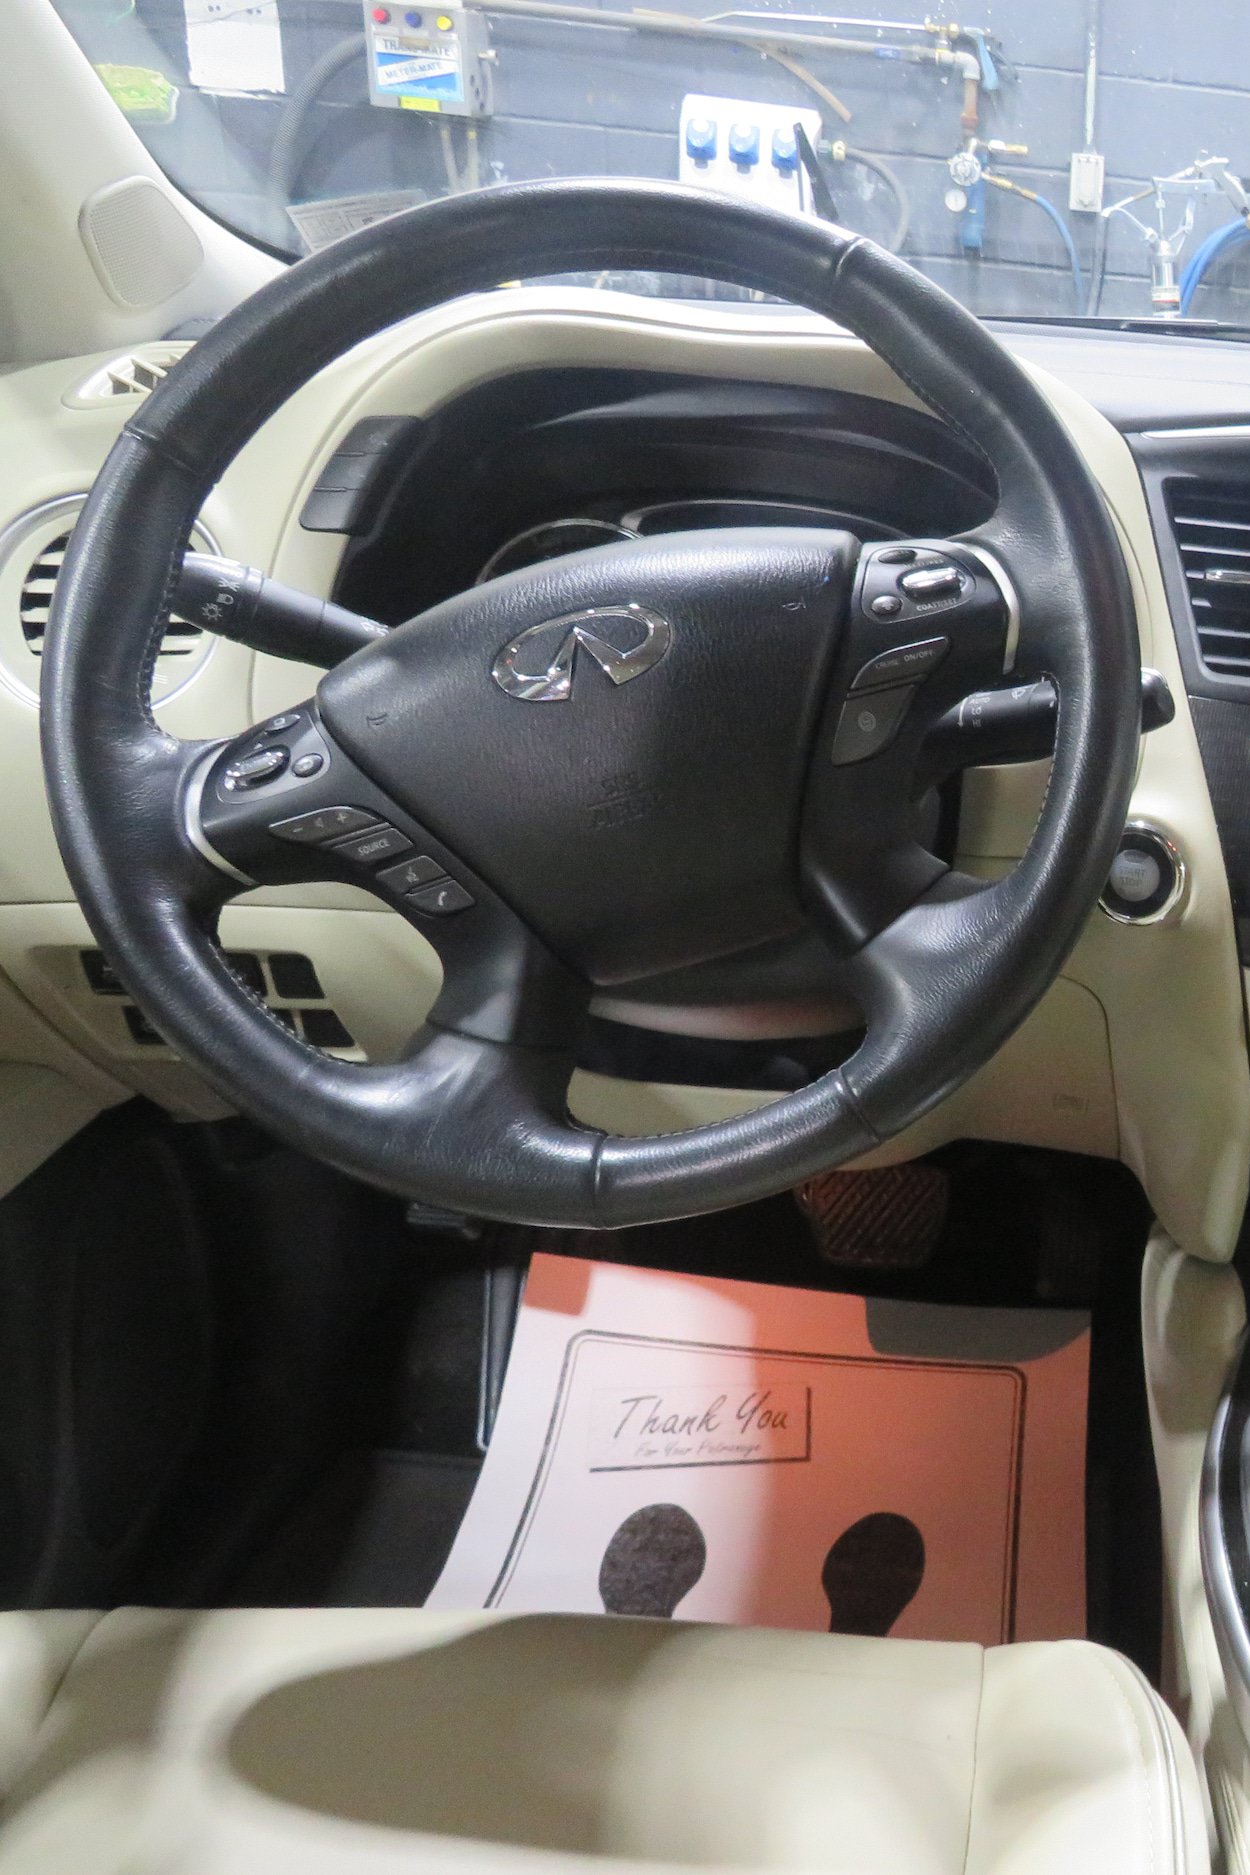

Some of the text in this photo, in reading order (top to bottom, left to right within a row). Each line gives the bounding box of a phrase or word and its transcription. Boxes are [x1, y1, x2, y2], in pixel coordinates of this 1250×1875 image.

[357, 838, 391, 857] SOURCE
[613, 1390, 788, 1440] Thank You
[633, 1442, 657, 1457] For
[664, 1440, 693, 1456] Your
